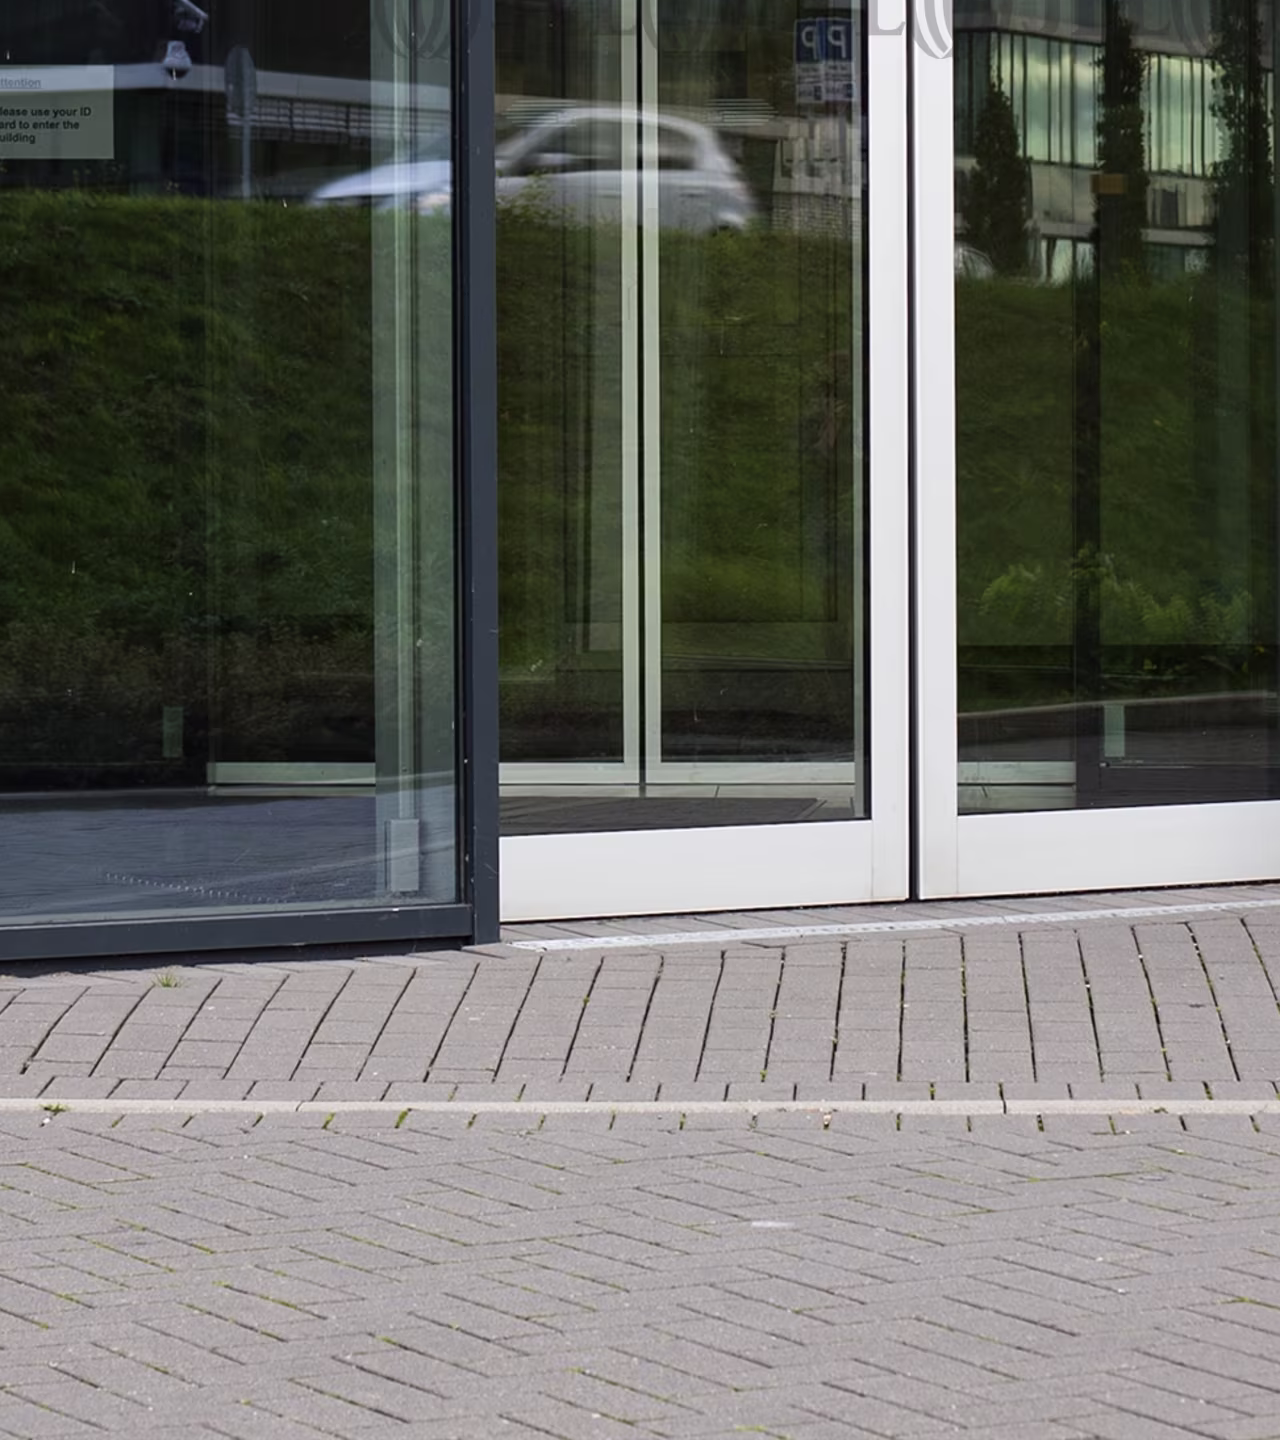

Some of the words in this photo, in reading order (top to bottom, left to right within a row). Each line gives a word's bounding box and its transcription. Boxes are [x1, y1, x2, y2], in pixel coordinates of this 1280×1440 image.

[30, 108, 50, 117] use
[52, 108, 78, 119] your
[80, 106, 92, 117] ID
[19, 120, 30, 130] to
[32, 120, 60, 130] enter
[63, 119, 80, 130] the
